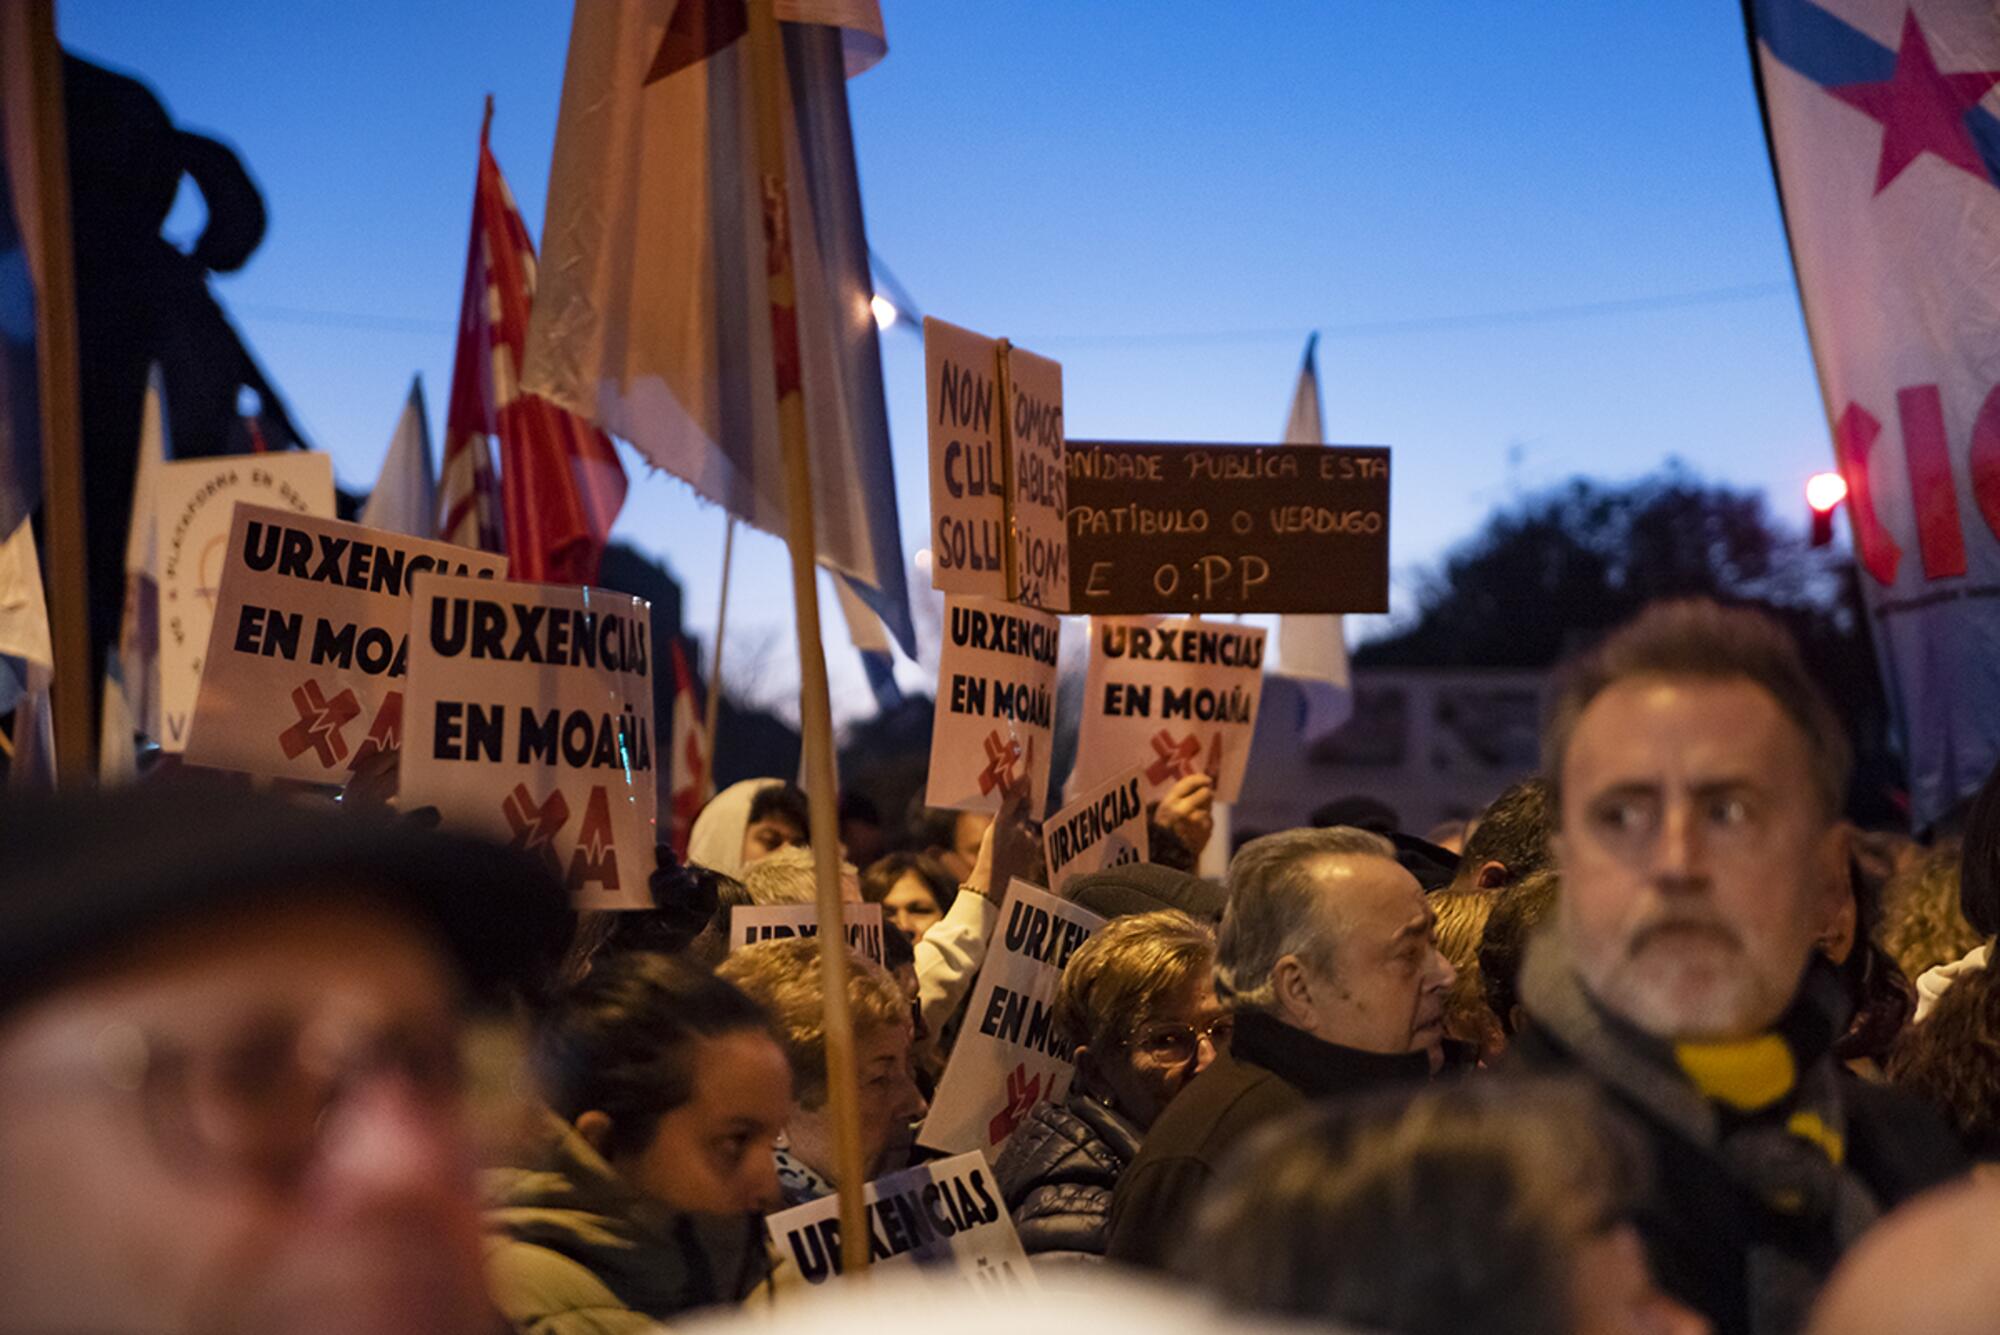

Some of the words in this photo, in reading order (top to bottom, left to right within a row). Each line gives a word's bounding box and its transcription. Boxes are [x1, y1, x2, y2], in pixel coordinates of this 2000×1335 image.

[939, 359, 993, 435] NON
[1013, 382, 1063, 460] OMOS
[944, 440, 1065, 522] CULABLES
[1065, 445, 1163, 480] ANIDADE
[1184, 447, 1300, 480] PUBLICA
[1068, 503, 1209, 536] PATIBULO
[1232, 510, 1252, 534] O
[1270, 506, 1383, 534] VERDUGO
[244, 521, 495, 598] URXENC
[234, 604, 303, 661] EN
[310, 618, 408, 678] MOA
[431, 597, 648, 677] URXENCIAS
[1102, 624, 1262, 669] URXENCIAS
[950, 674, 987, 717] EN
[1103, 682, 1151, 718] EN
[1162, 684, 1250, 724] MOAÑA
[434, 701, 504, 763] EN
[518, 704, 651, 770] MOAÑA
[1049, 777, 1140, 874] URXENCIAS
[1005, 900, 1091, 970] URXEN
[979, 985, 1030, 1044] EN
